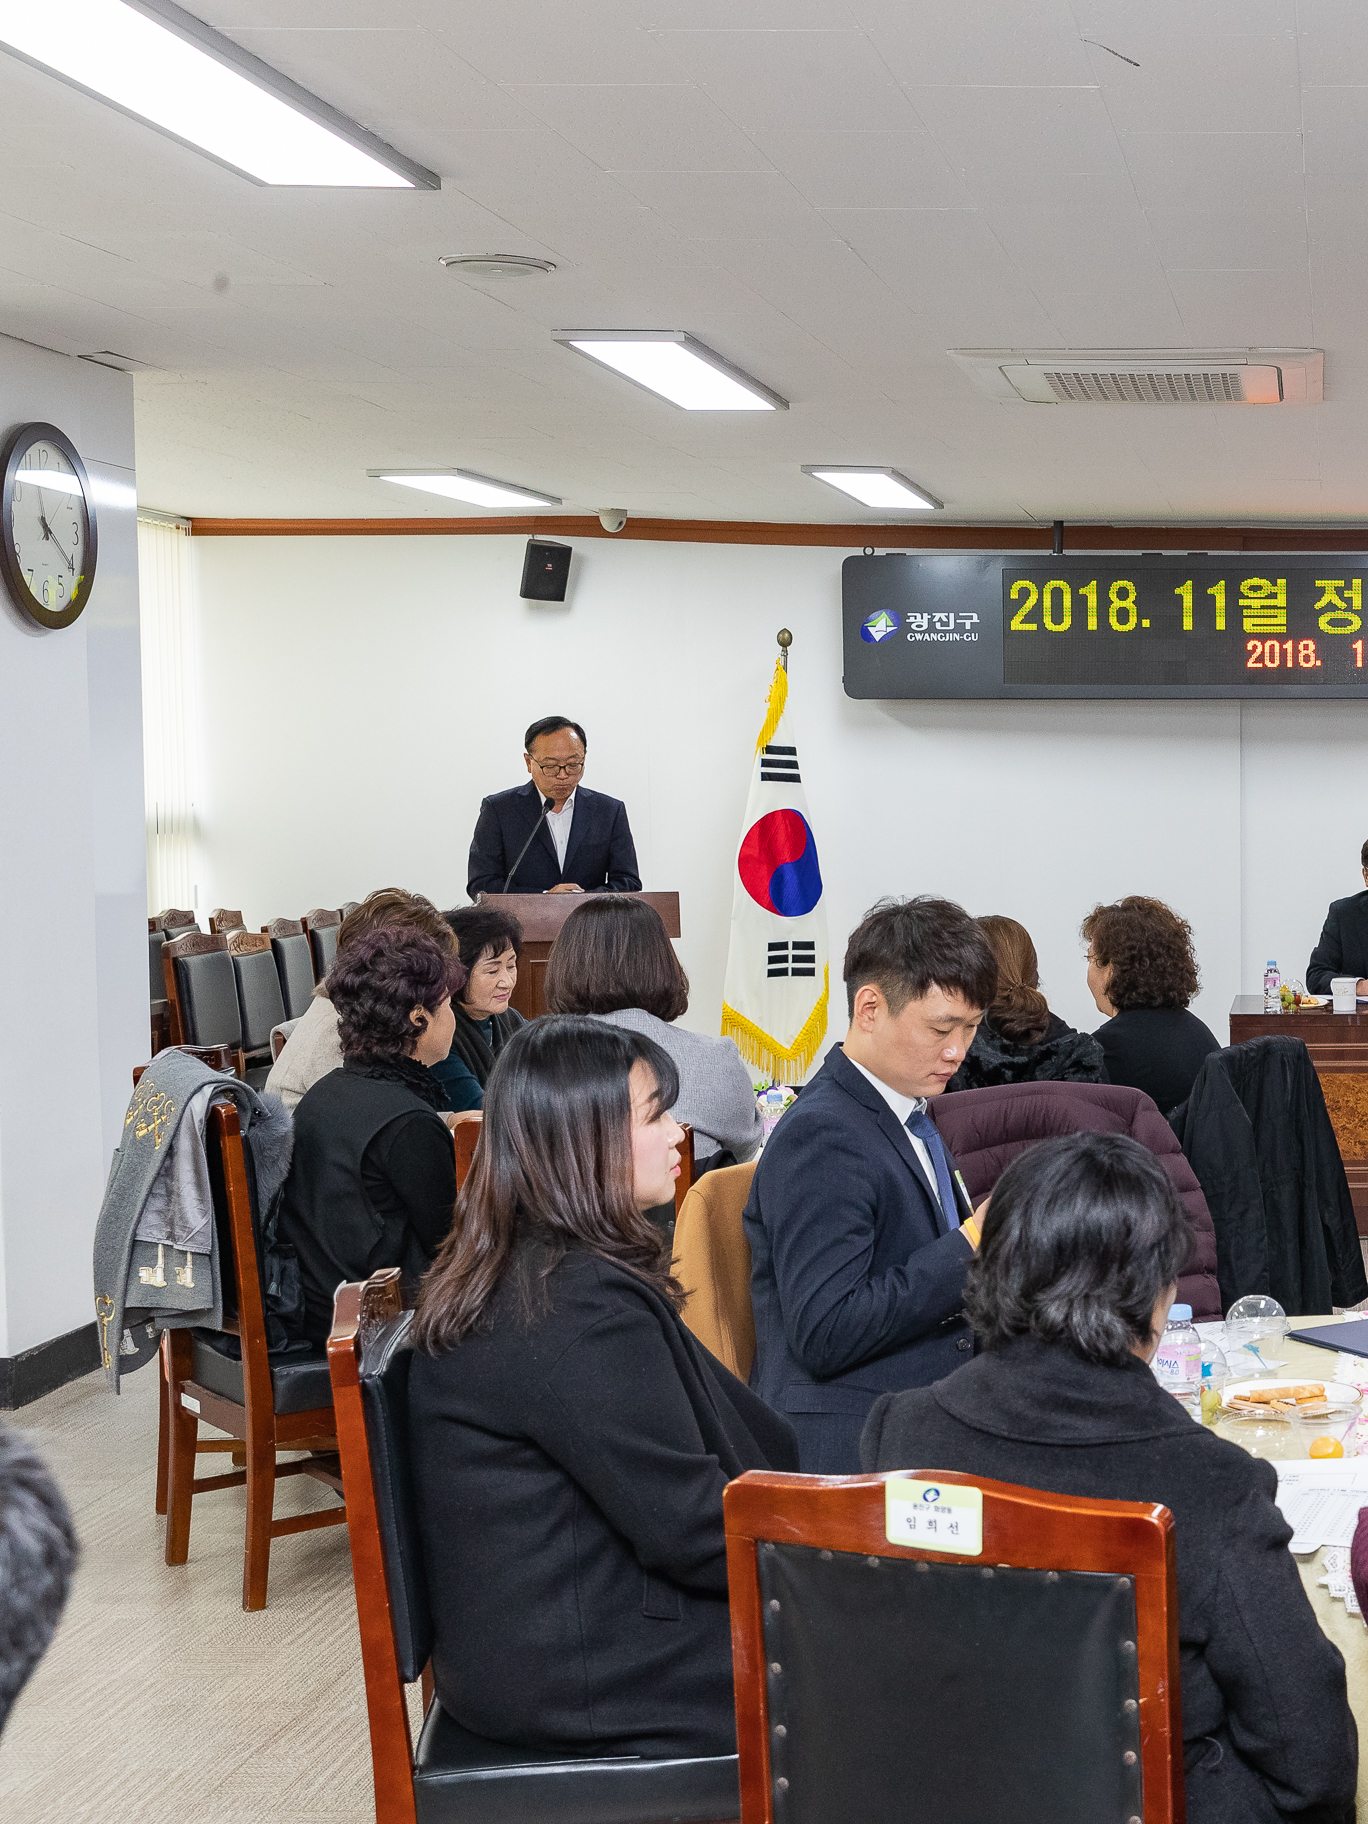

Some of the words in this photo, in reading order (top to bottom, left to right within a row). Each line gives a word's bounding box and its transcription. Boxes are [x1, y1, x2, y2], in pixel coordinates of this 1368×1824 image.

[71, 521, 79, 546] 3
[67, 553, 75, 577] 4
[42, 579, 50, 604] 6
[57, 574, 65, 599] 5
[1009, 578, 1151, 632] 2018.
[1174, 576, 1288, 634] 11월
[905, 612, 980, 631] 광진구
[906, 632, 979, 641] GWANGJIN-GU
[1246, 639, 1322, 668] 2018.
